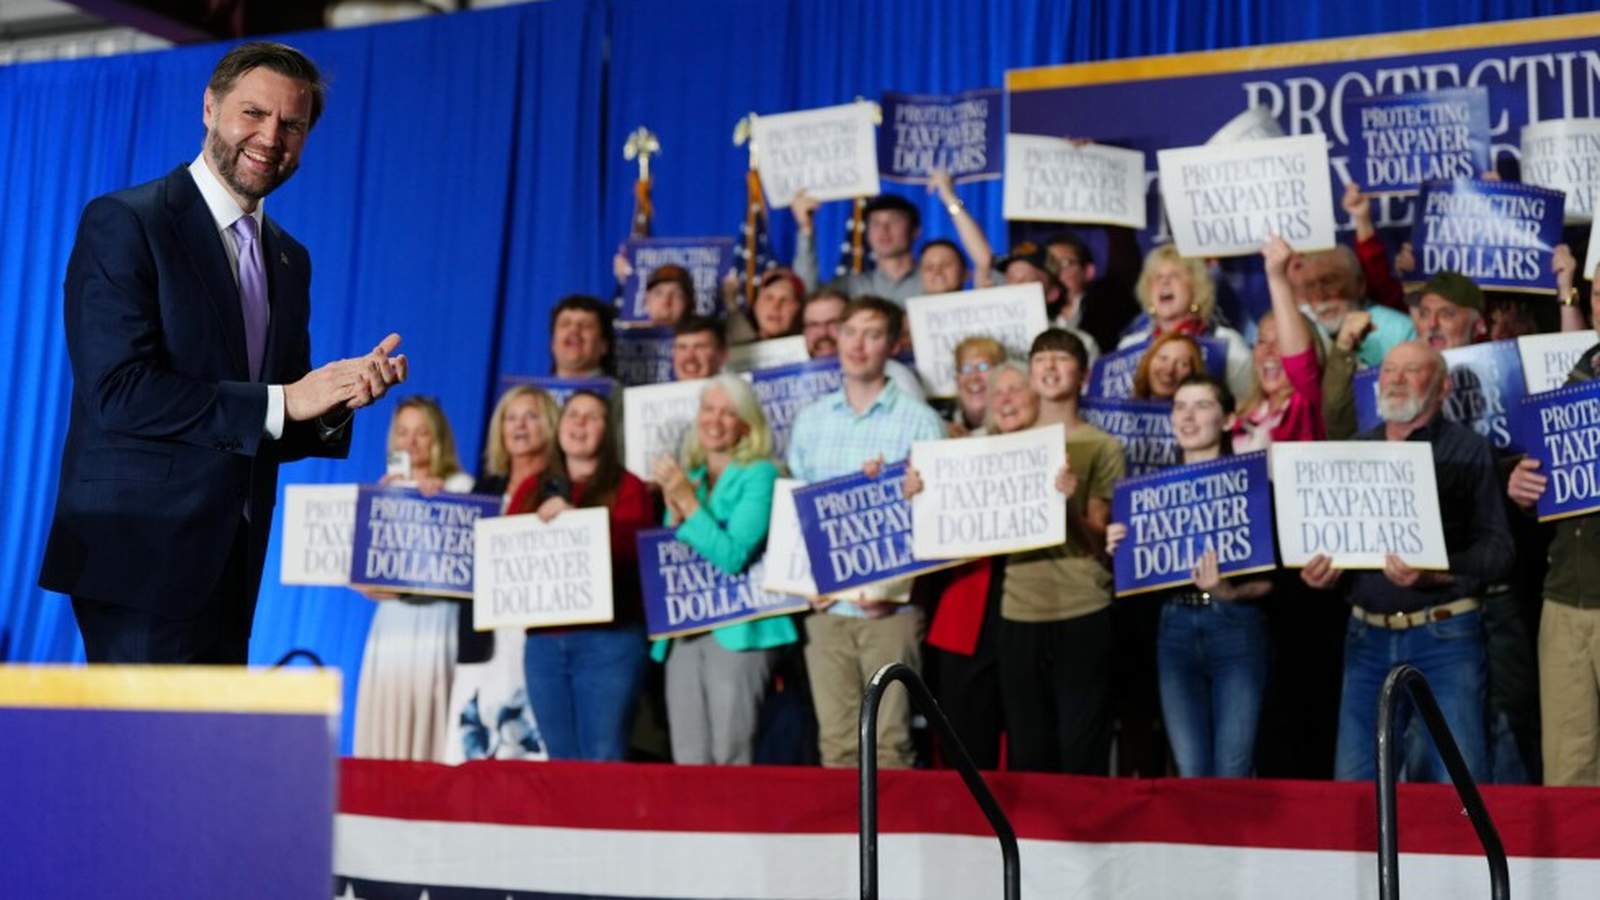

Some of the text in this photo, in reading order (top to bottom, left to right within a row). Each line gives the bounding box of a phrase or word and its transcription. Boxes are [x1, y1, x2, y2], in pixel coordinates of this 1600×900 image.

[1243, 50, 1600, 147] PROCTI
[1361, 102, 1469, 129] PROTECTING
[1362, 125, 1470, 156] TAXPAYER
[1024, 168, 1128, 191] TAXPAYER
[1181, 153, 1306, 187] PROTECTING
[1367, 153, 1474, 187] DOLLARS
[1024, 189, 1128, 214] DOLLARS
[1185, 180, 1309, 216] TAXPAYER
[1426, 192, 1545, 220] PROTECTING
[1191, 210, 1312, 247] DOLLARS
[1424, 215, 1541, 246] TAXPAYER
[1422, 245, 1540, 280] DOLLARS
[935, 447, 1048, 480] PROTECTING
[1295, 459, 1416, 486] PROTECTING
[936, 474, 1048, 511] TAXPAYER
[1130, 468, 1249, 514] PROTECTING
[1296, 487, 1419, 518] TAXPAYER
[370, 498, 483, 525] PROTECTING
[937, 504, 1049, 545] DOLLARS
[1130, 496, 1251, 544] TAXPAYER
[369, 522, 475, 555] TAXPAYER
[490, 527, 591, 556] PROTECTING
[1133, 527, 1253, 580] DOLLARS
[1301, 521, 1424, 555] DOLLARS
[366, 547, 472, 585] DOLLARS
[491, 551, 591, 582] TAXPAYER
[492, 581, 593, 616] DOLLARS
